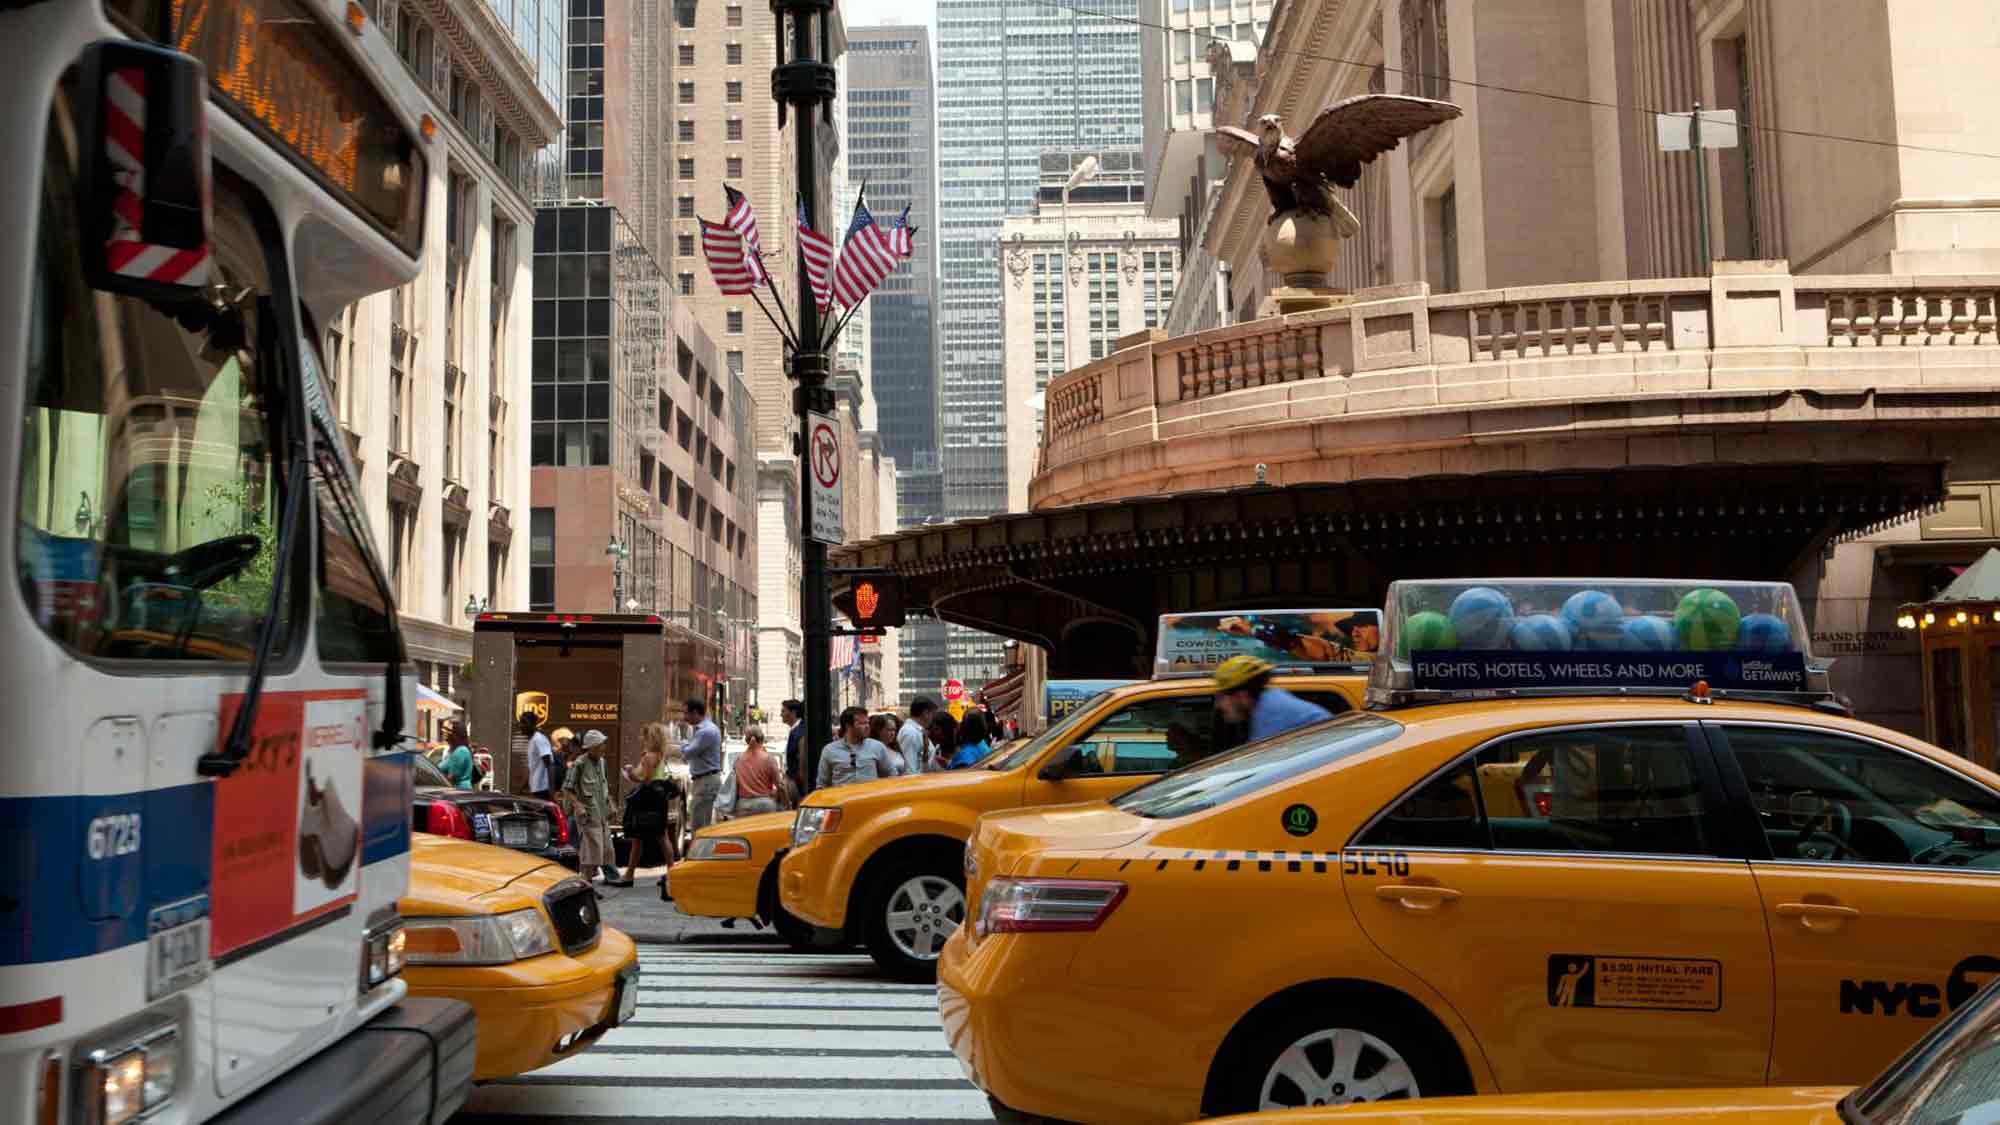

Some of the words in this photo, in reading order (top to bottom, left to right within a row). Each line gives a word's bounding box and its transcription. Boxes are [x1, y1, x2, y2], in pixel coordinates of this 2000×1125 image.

[1811, 632, 1853, 642] GRAND
[1417, 662, 1481, 680] FLIGHTS,
[1485, 662, 1546, 680] HOTELS,
[1549, 662, 1612, 679] WHEELS
[1616, 663, 1654, 678] AND
[1742, 670, 1801, 682] GETAWAYS
[88, 814, 142, 860] 6723
[1839, 978, 1941, 1018] NYC
